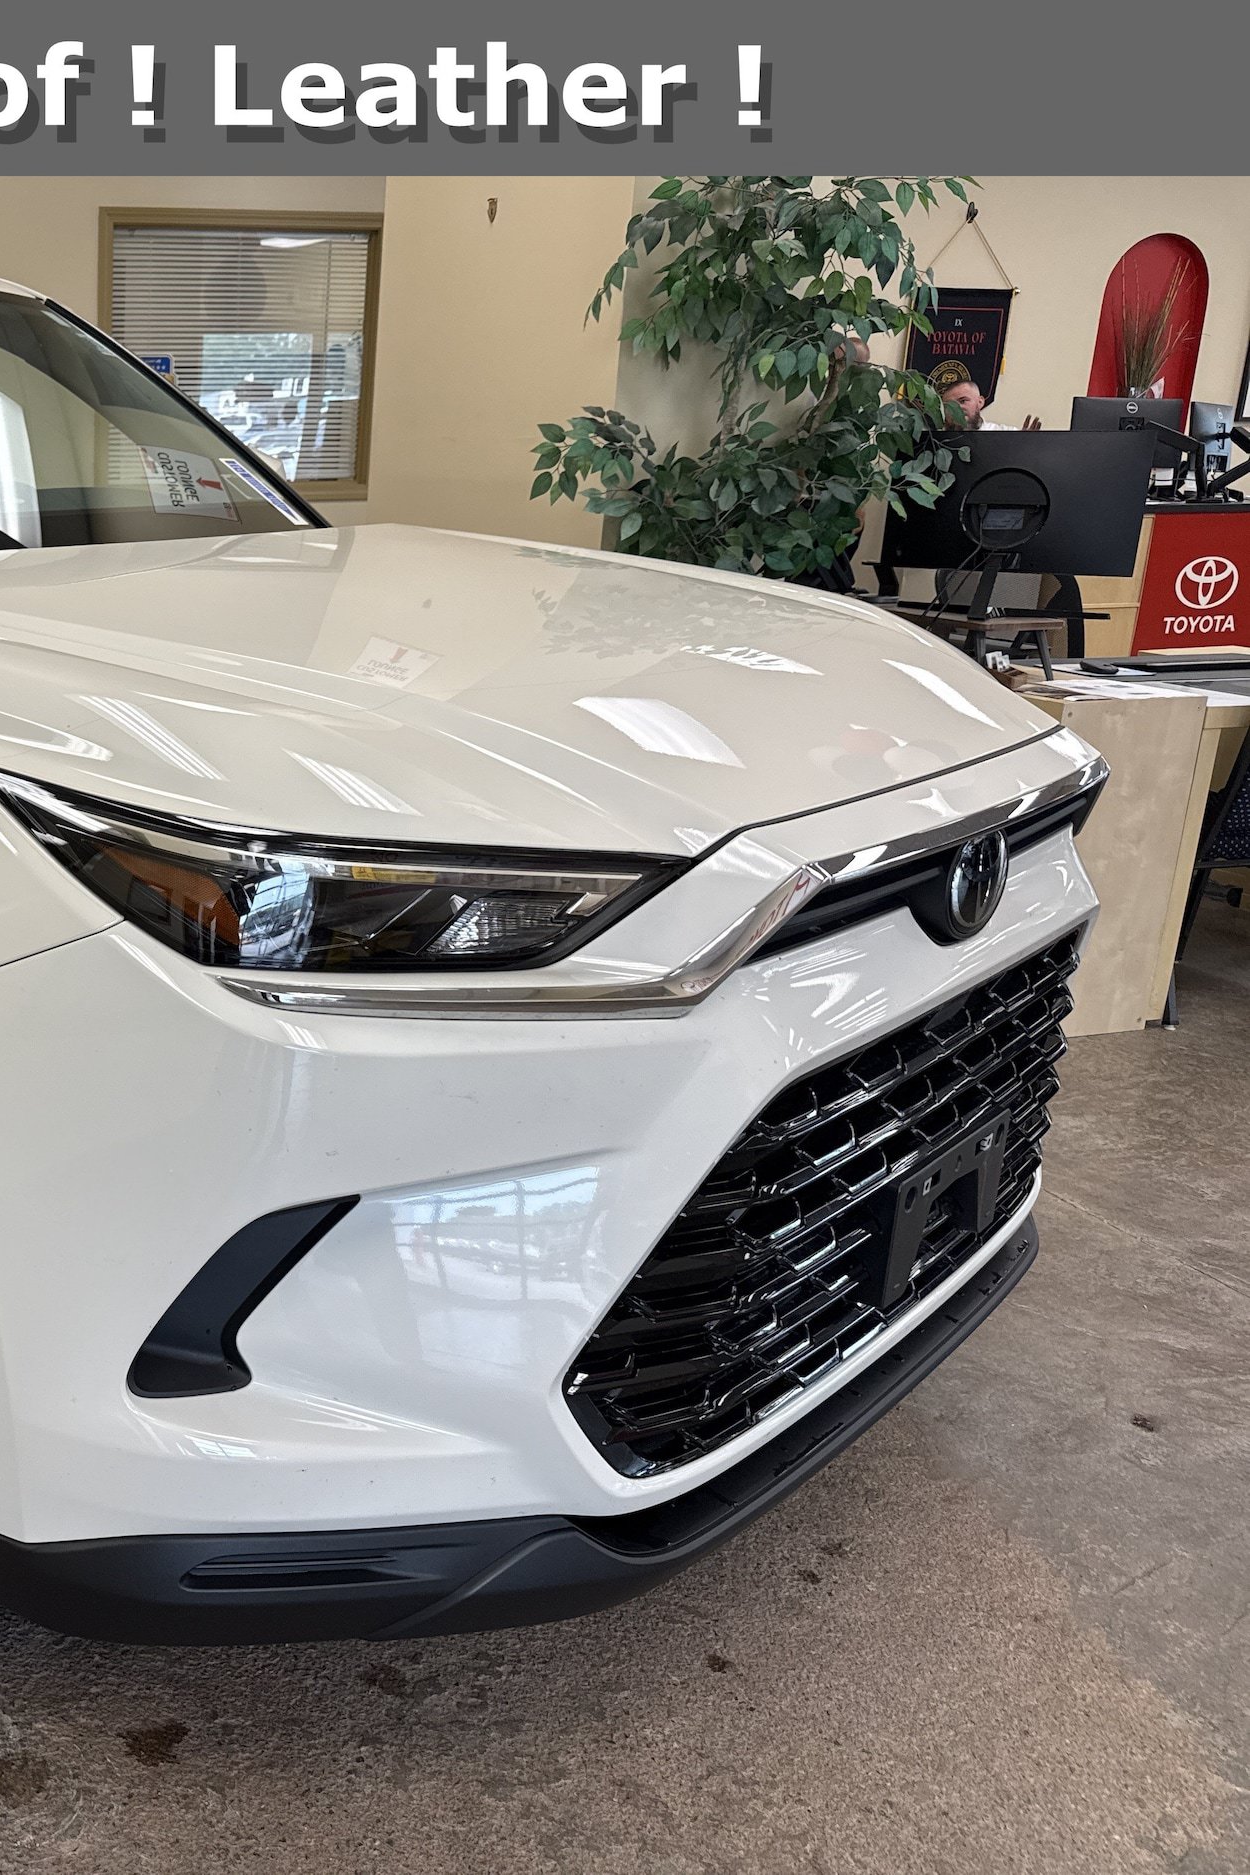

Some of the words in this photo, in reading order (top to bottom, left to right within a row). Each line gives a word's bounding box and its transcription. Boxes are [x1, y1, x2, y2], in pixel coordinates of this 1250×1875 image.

[971, 332, 986, 343] OF
[932, 343, 976, 356] BATAVIA
[1163, 614, 1236, 634] TOYOTA
